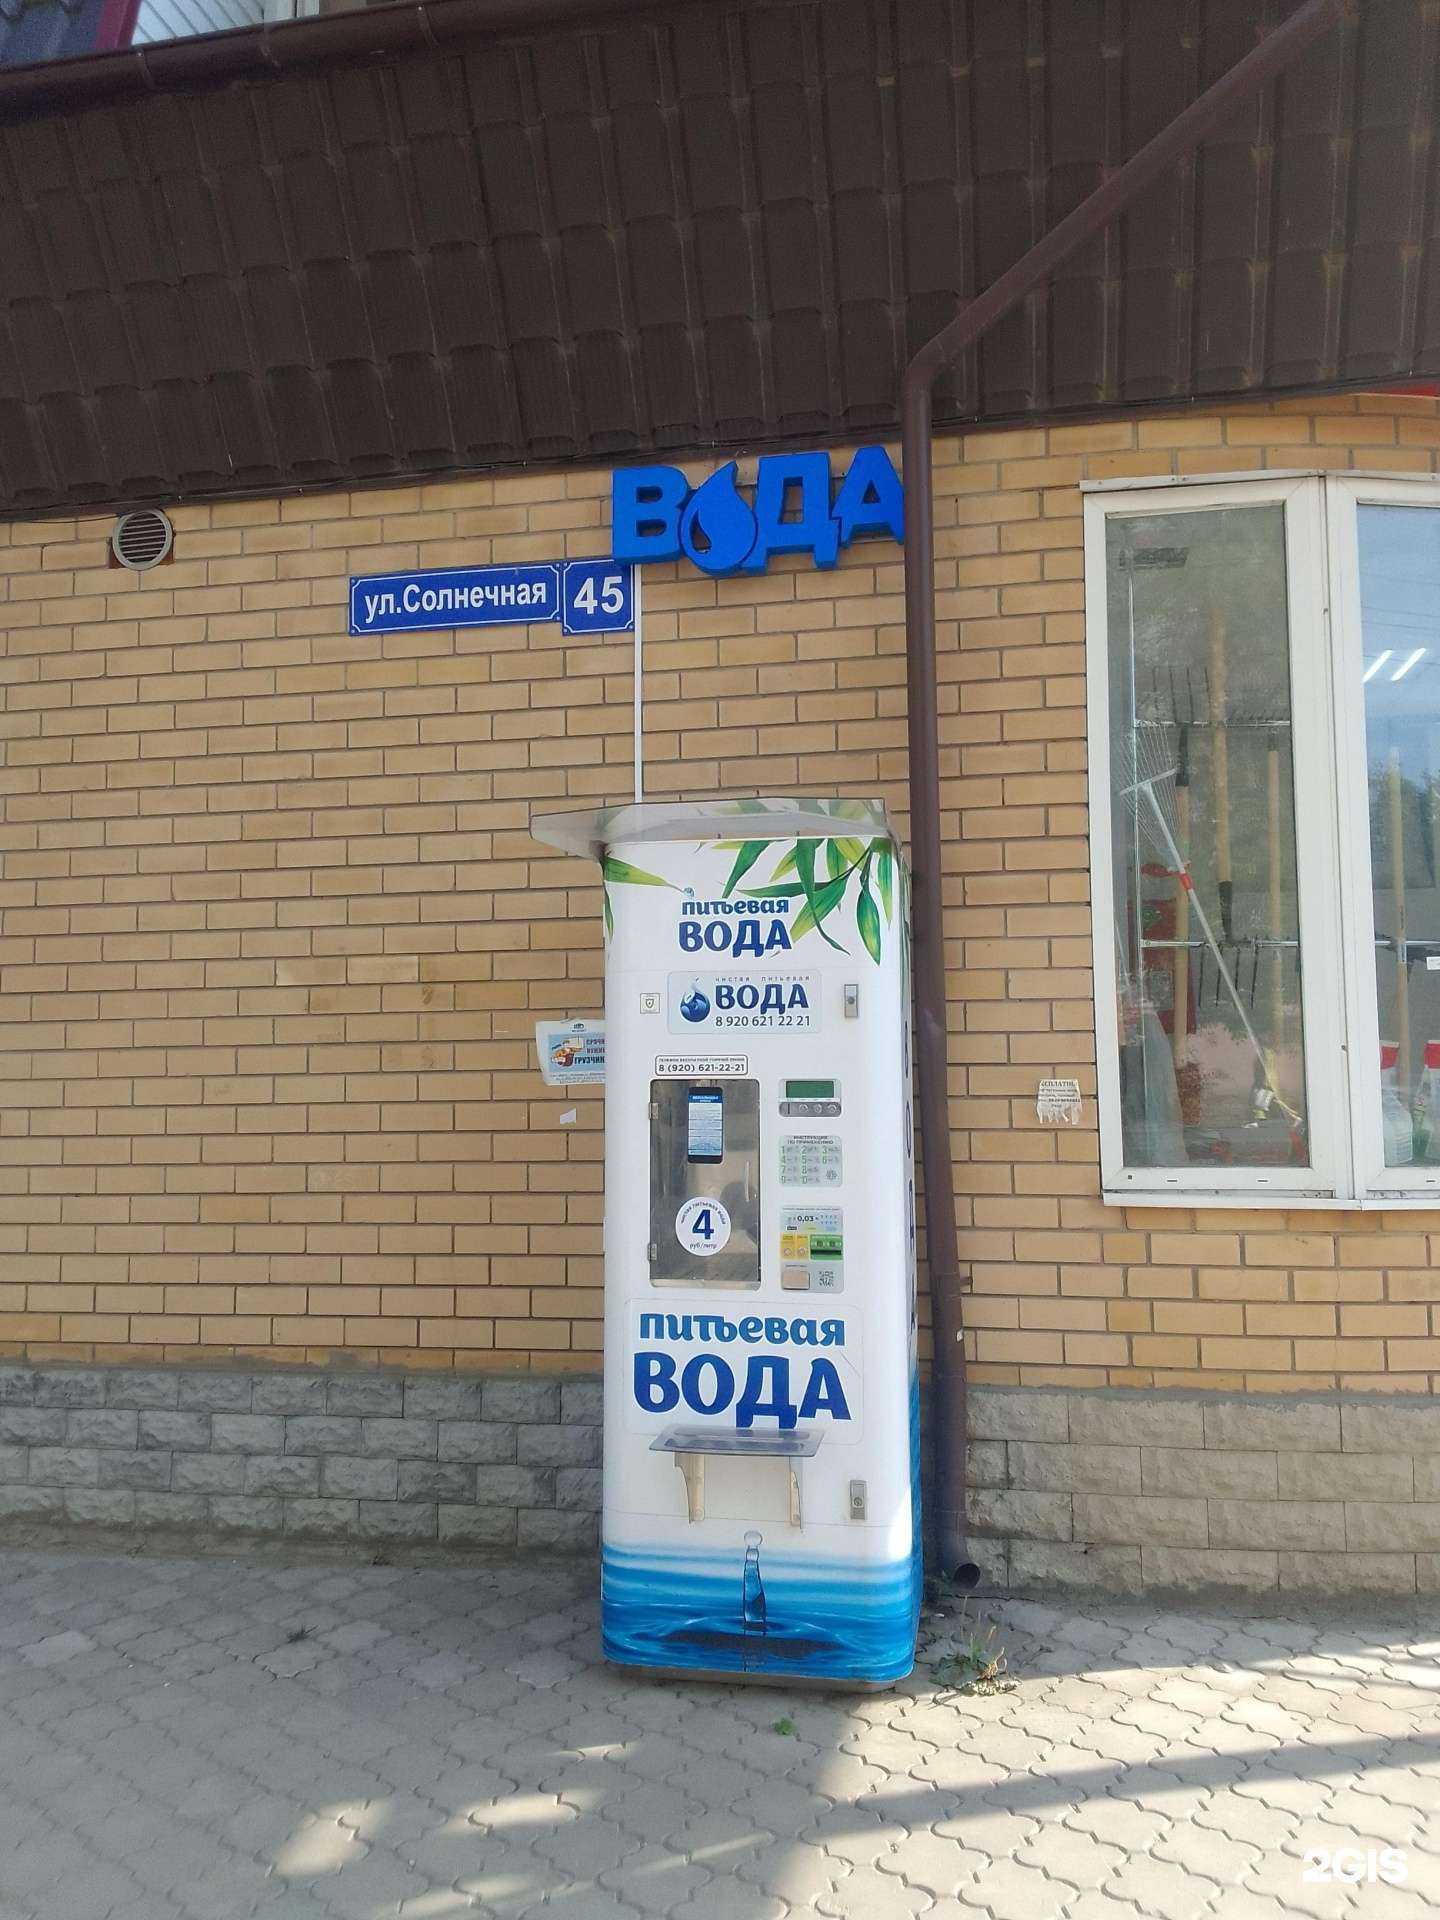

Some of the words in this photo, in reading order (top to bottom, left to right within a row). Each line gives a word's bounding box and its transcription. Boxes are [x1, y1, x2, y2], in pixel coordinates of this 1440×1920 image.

[365, 582, 547, 623] ул.Солнечная
[573, 576, 624, 615] 45
[682, 900, 789, 915] питьевая
[679, 919, 792, 958] ВОДА
[715, 983, 809, 1014] ВОДА
[715, 1016, 723, 1026] 8
[726, 1016, 749, 1026] 920
[752, 1016, 773, 1026] 621
[778, 1016, 793, 1026] 22
[796, 1016, 810, 1026] 21
[659, 1064, 665, 1072] 8
[668, 1064, 695, 1072] (920)
[698, 1064, 745, 1072] 621-22-21
[692, 1209, 715, 1239] 4
[640, 1313, 845, 1347] питьевая
[633, 1351, 852, 1429] ВОДА
